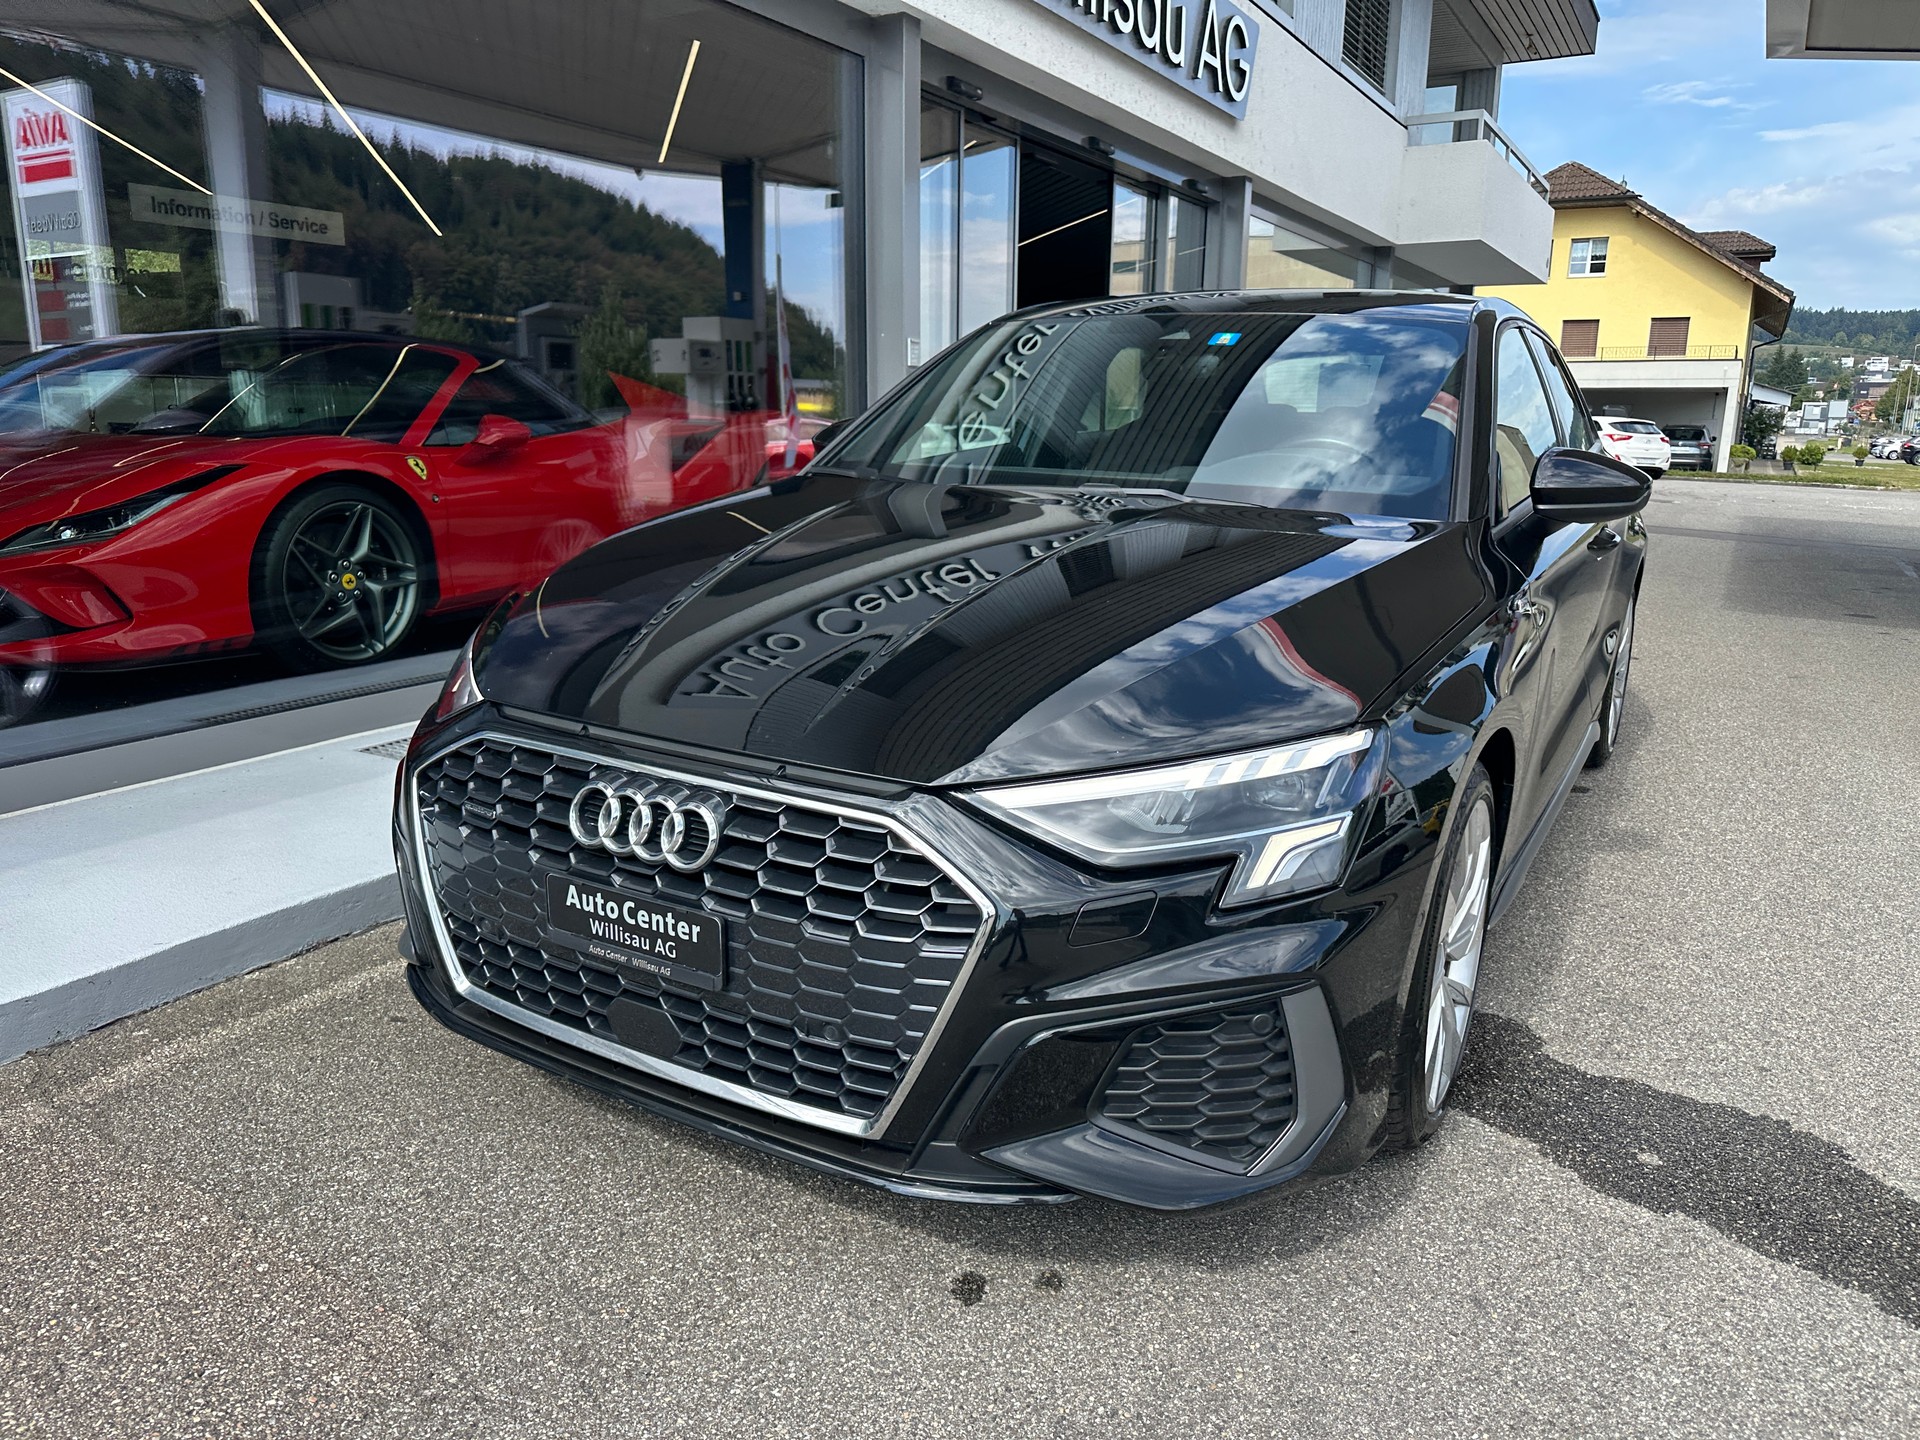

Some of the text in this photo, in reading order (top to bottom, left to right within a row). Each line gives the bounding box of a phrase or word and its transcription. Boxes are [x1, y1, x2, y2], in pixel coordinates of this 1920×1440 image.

[1196, 0, 1250, 102] AG
[151, 196, 255, 225] Information
[268, 212, 328, 235] Service
[565, 884, 701, 943] Auto Center
[589, 918, 677, 959] Willisau AG
[589, 944, 671, 976] Auto Center Willisau AG
